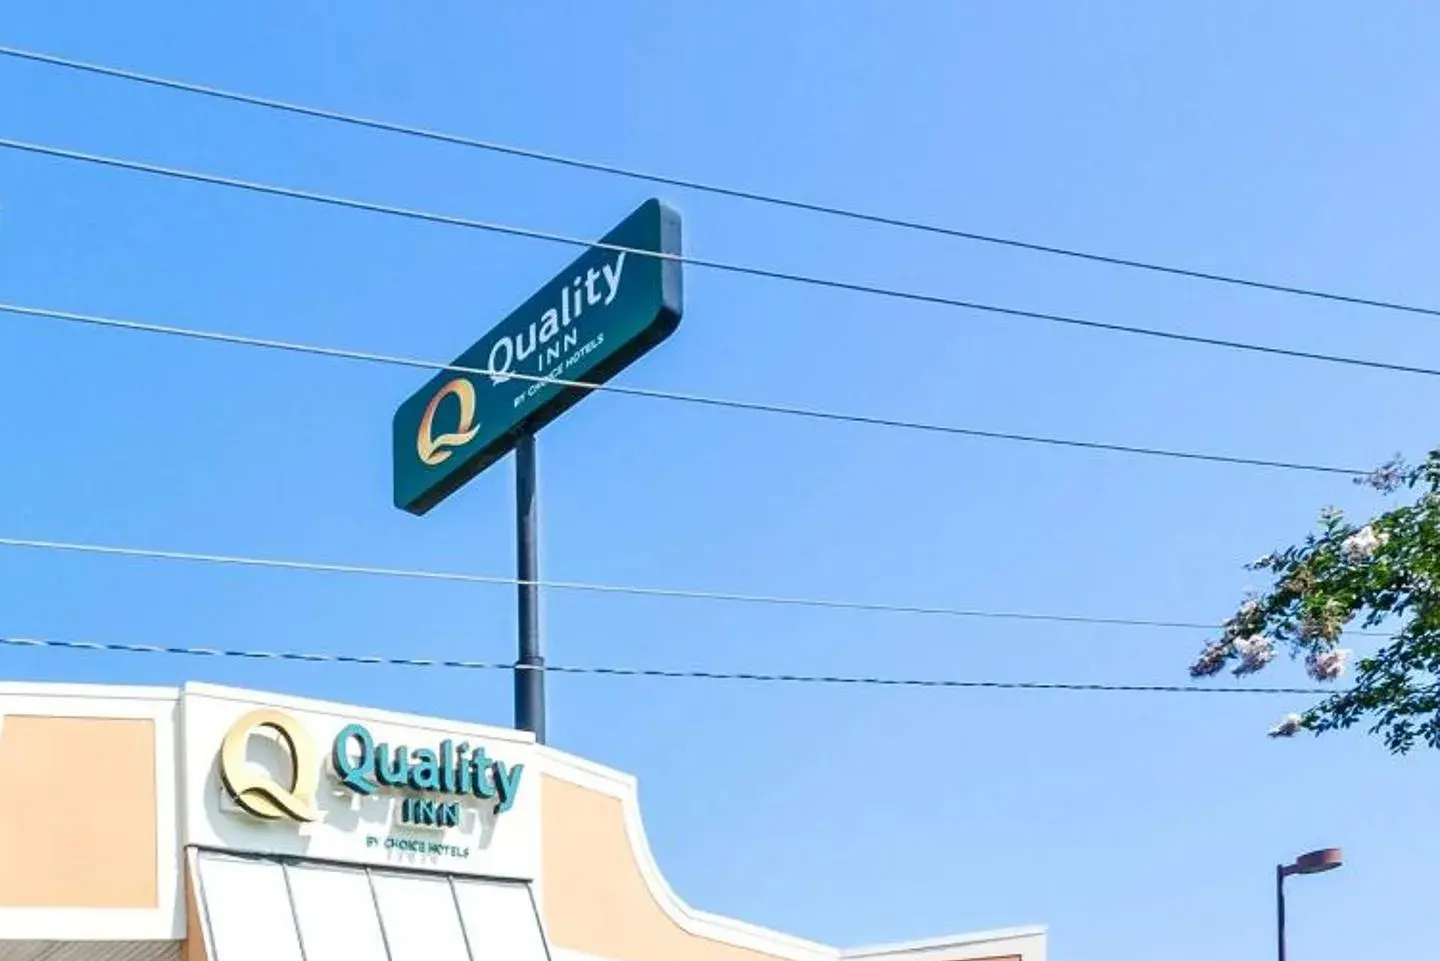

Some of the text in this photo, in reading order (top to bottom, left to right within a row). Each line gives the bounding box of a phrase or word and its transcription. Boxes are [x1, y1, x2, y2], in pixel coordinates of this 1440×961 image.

[488, 251, 626, 386] Quality
[538, 327, 577, 372] INN
[527, 362, 564, 396] CHOCE
[565, 332, 604, 368] HOTELS
[417, 378, 481, 466] Q
[220, 708, 318, 822] Q
[332, 723, 524, 815] Quality
[384, 838, 426, 853] CHOICE
[428, 842, 469, 858] HOTELS
[402, 797, 461, 827] INN
